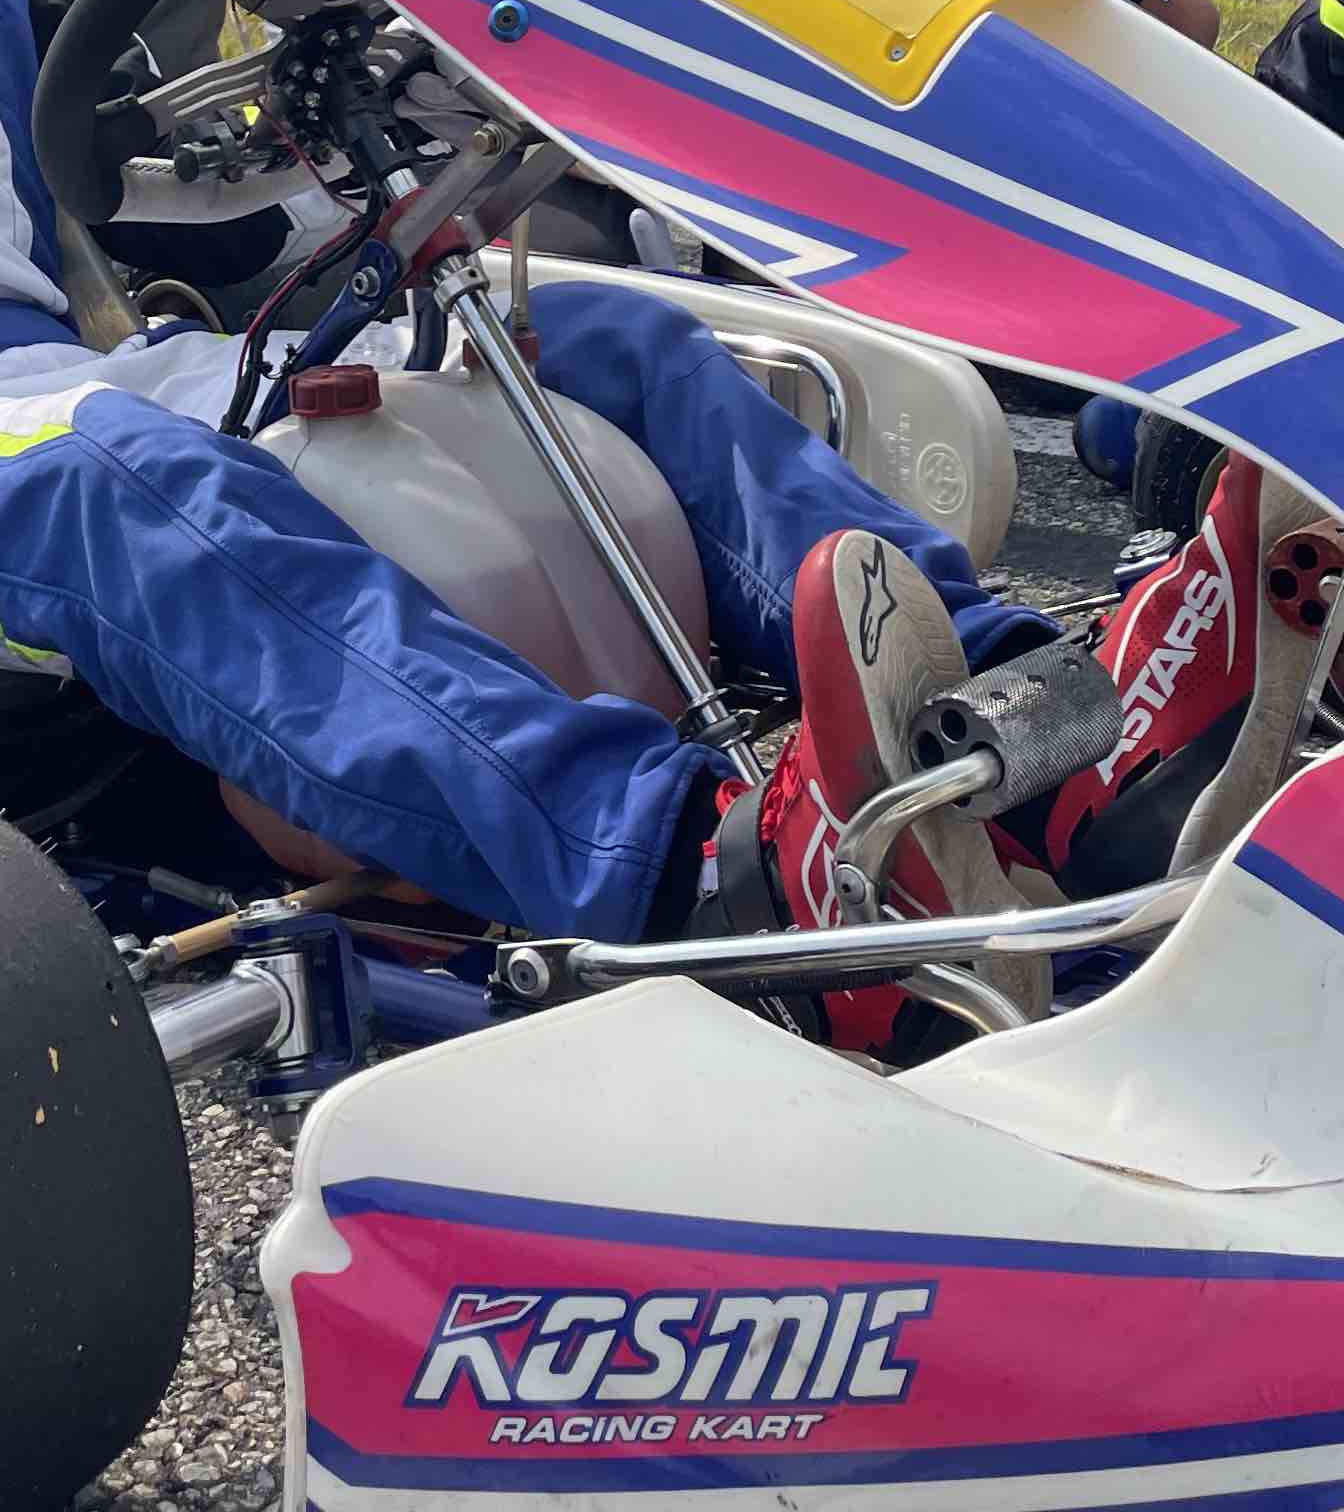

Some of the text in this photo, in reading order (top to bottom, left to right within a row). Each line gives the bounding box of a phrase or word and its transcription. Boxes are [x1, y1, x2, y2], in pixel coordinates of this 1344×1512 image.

[413, 1289, 931, 1403] KOSMIC
[488, 1412, 825, 1445] RACING KART
